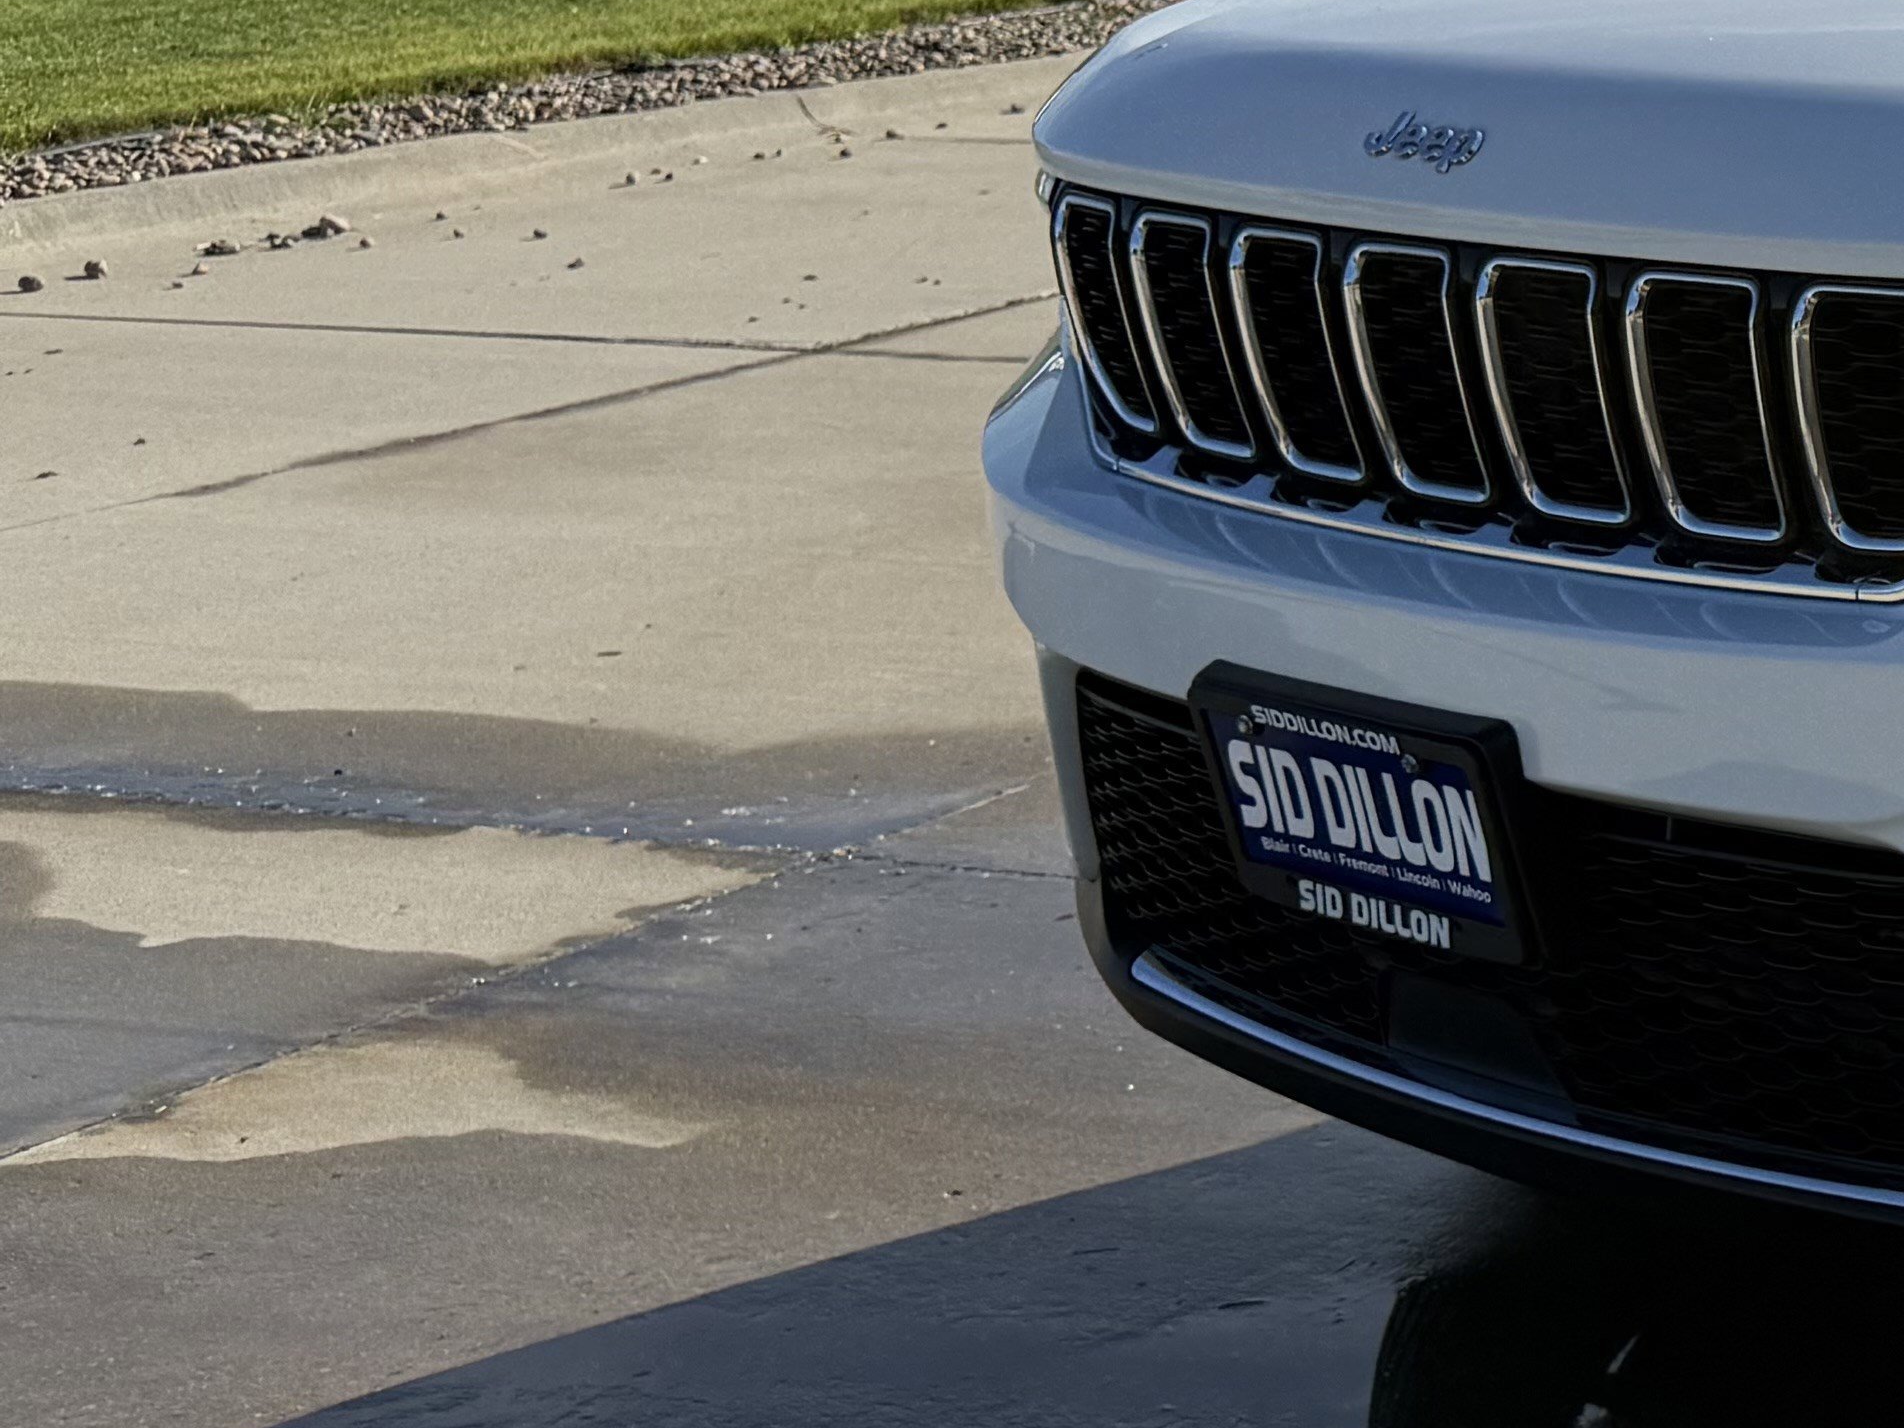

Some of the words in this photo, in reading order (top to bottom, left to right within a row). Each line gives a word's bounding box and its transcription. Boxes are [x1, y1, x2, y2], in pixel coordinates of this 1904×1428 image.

[1364, 110, 1485, 174] Jeep
[1250, 704, 1401, 756] SIDDILLON.COM
[1227, 739, 1315, 839] SID
[1309, 756, 1492, 882] DILLON
[1298, 879, 1344, 919] SID
[1351, 894, 1451, 950] DILLON
[1397, 867, 1441, 890] Lincoln
[1447, 879, 1492, 904] Wahoo
